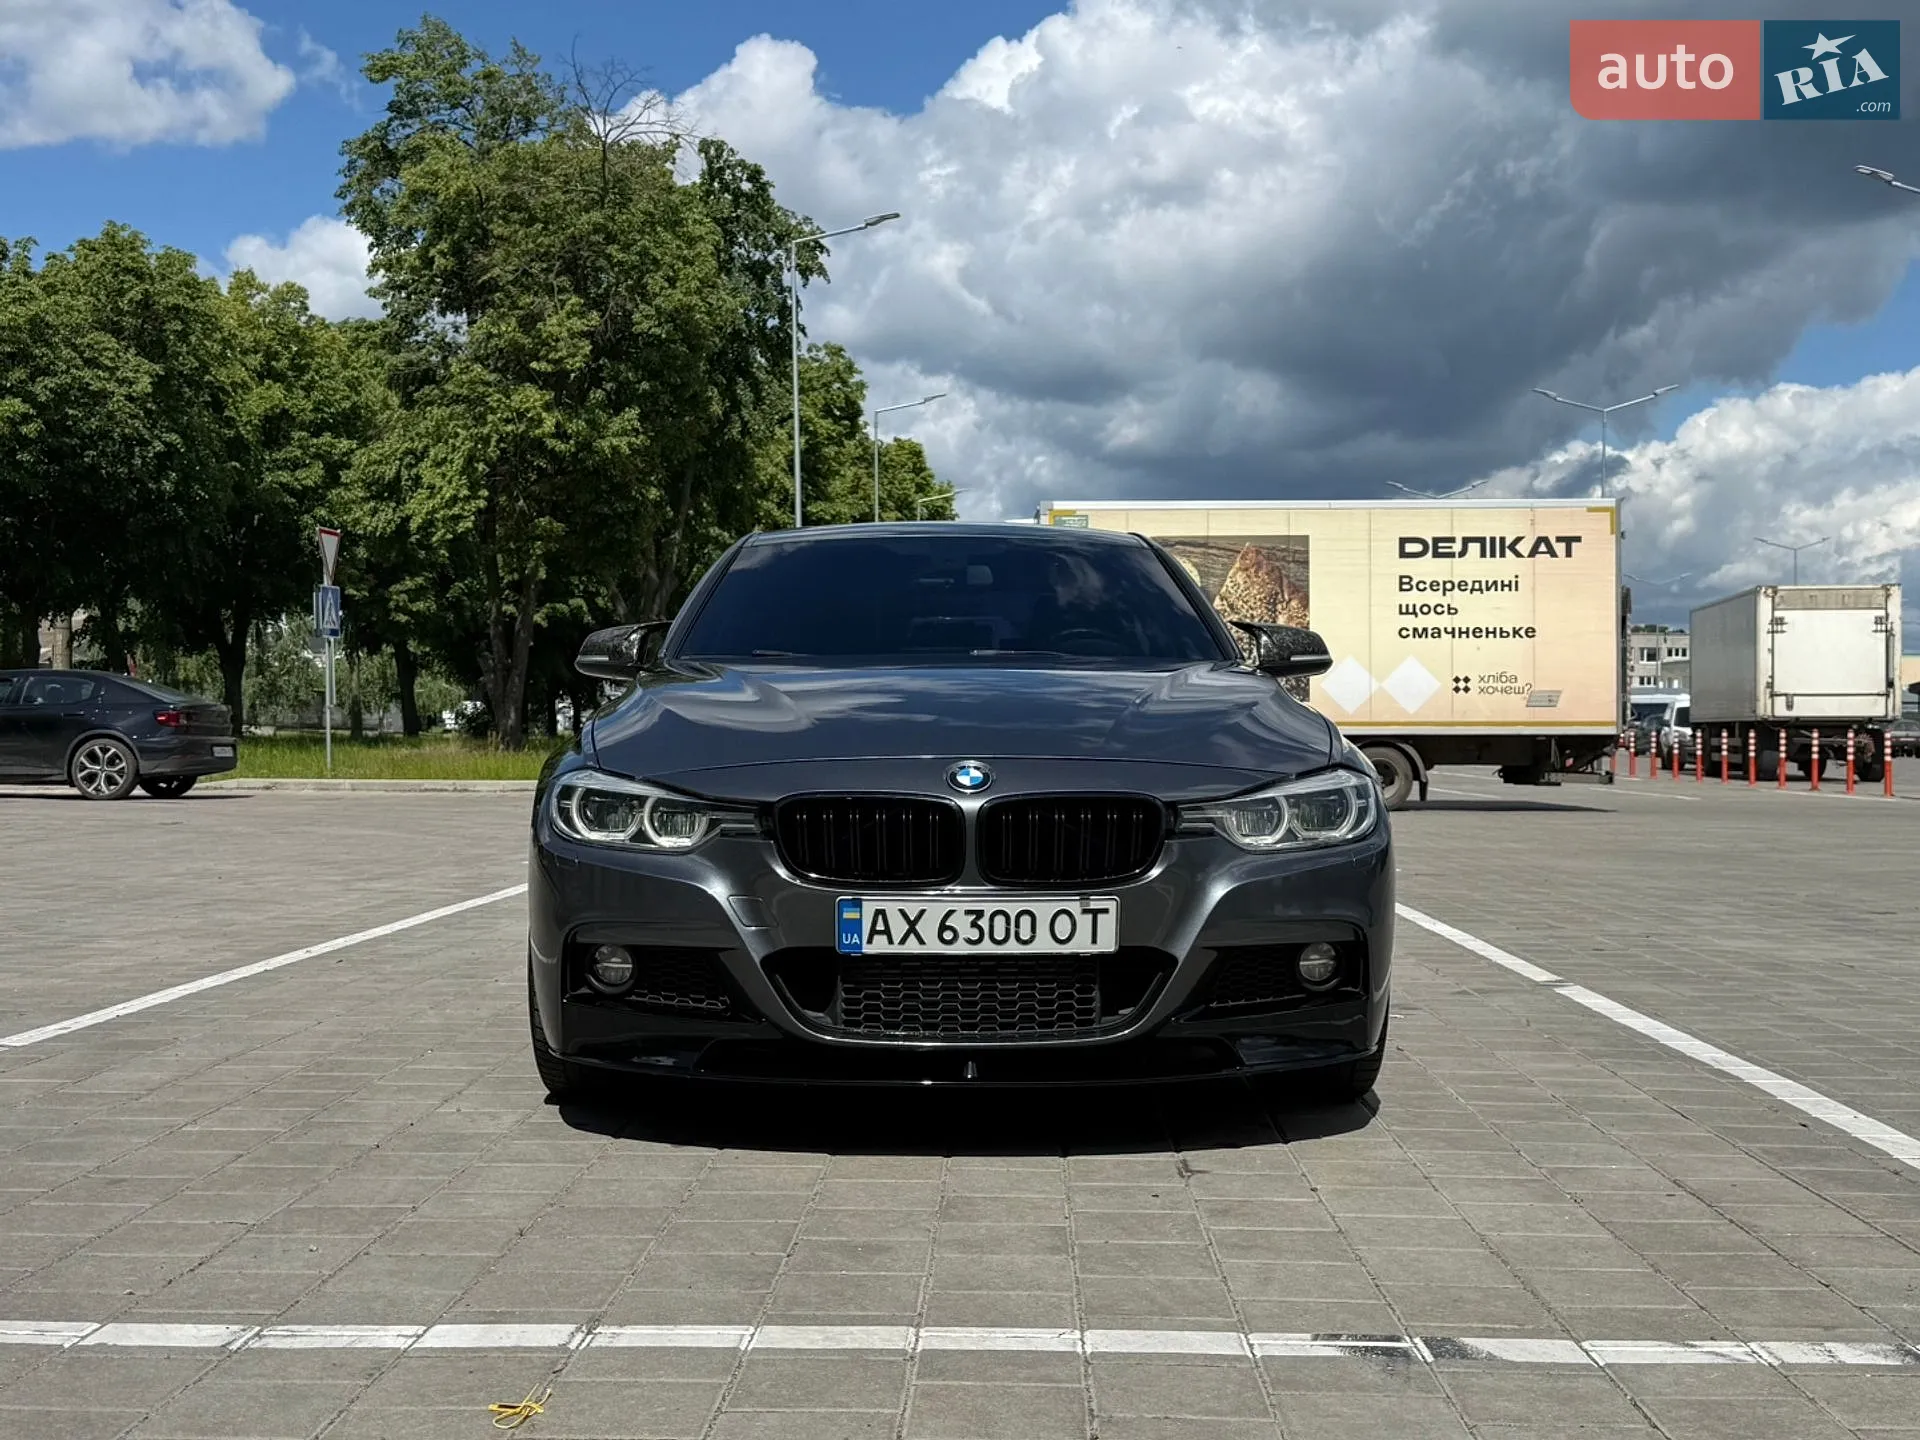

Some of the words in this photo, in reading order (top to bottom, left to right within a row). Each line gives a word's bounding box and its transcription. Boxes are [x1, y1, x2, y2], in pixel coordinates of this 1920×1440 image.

[1398, 574, 1520, 596] Всередині
[1398, 602, 1459, 618] щось
[1397, 626, 1537, 639] смачненьке
[1478, 671, 1518, 684] хліба
[1478, 682, 1532, 695] хочеш?
[866, 908, 927, 946] AX
[937, 909, 1037, 946] 6300
[1050, 908, 1110, 946] OT
[842, 934, 861, 945] UA
